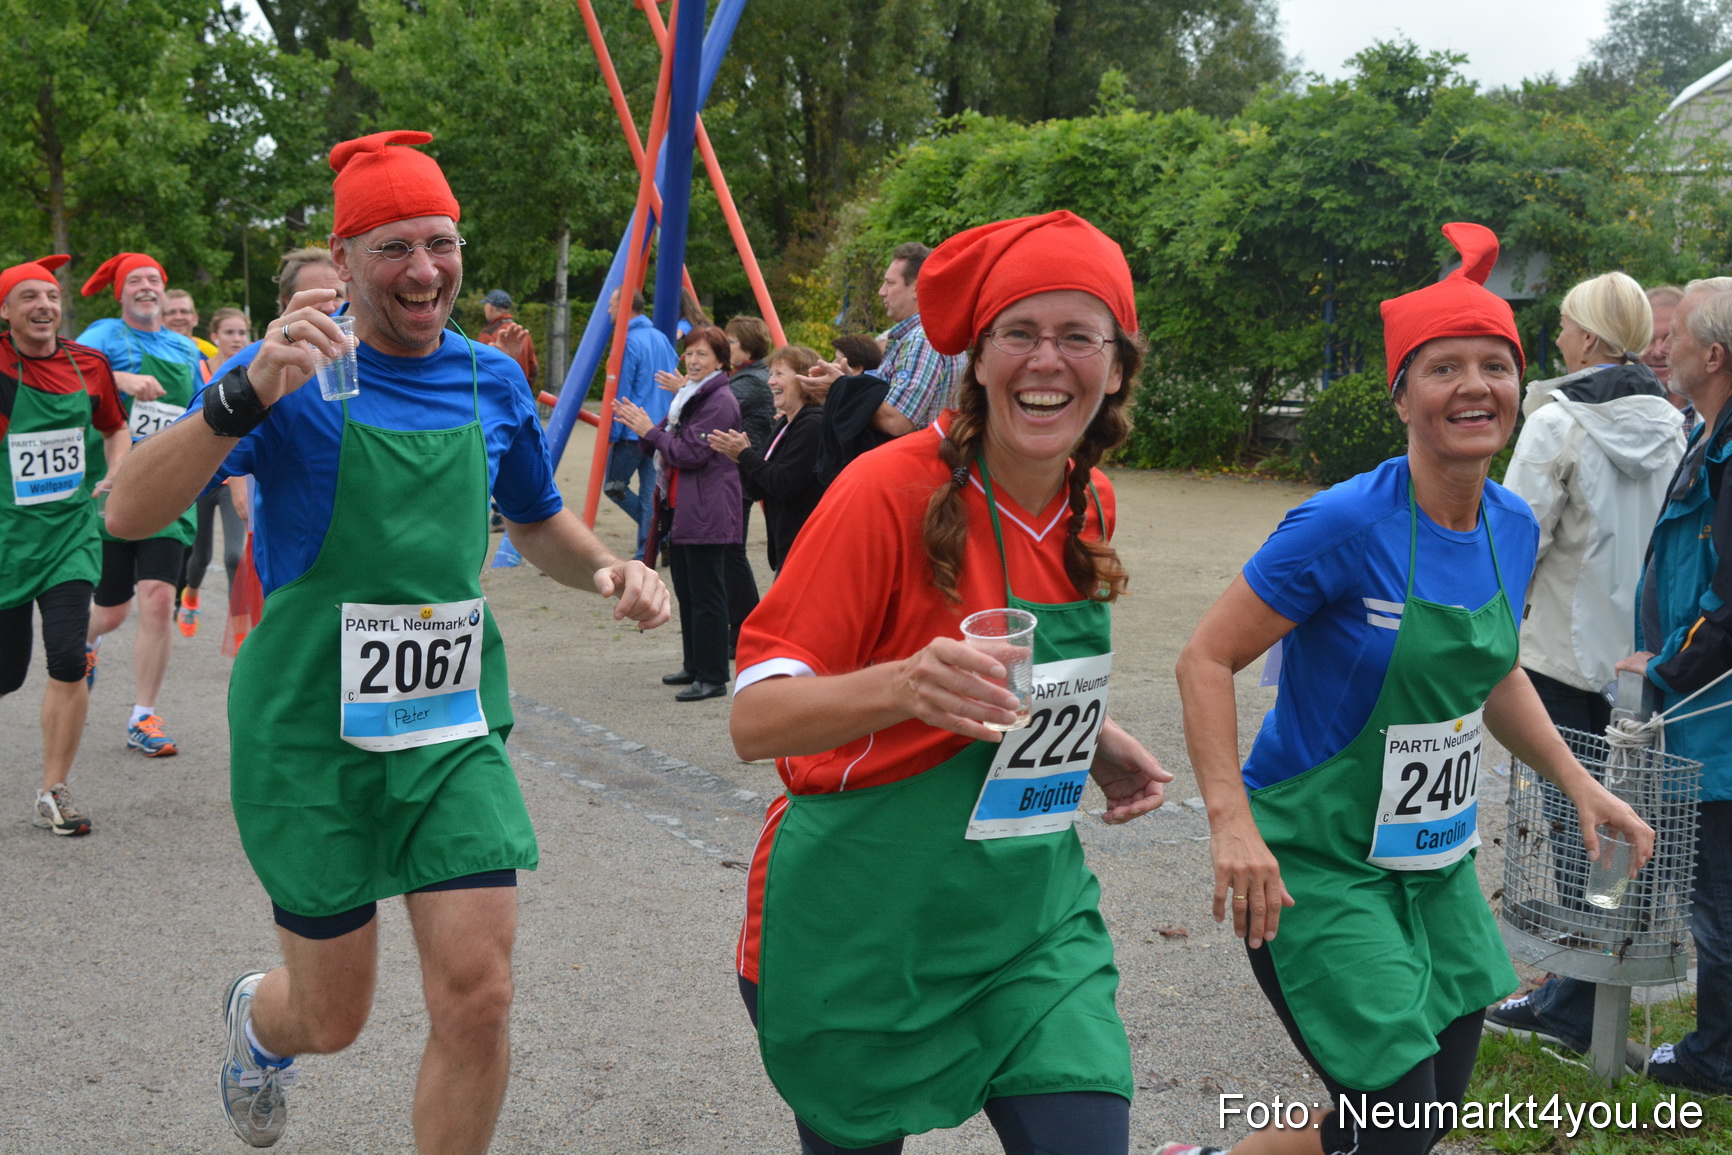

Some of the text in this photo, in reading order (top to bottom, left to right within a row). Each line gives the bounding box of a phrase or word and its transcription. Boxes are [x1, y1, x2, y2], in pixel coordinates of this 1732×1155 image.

[11, 436, 75, 448] PARTL Neumarkt
[20, 445, 79, 477] 2153
[29, 479, 74, 494] Wolfgang
[345, 616, 467, 632] PARTL Neumarkt
[359, 633, 473, 695] 2067
[394, 705, 430, 728] Peter
[1006, 698, 1107, 769] 222
[1389, 738, 1441, 755] PARTL
[1394, 740, 1482, 817] 2407
[1018, 781, 1083, 813] Brigitte
[1415, 819, 1466, 850] Carolin
